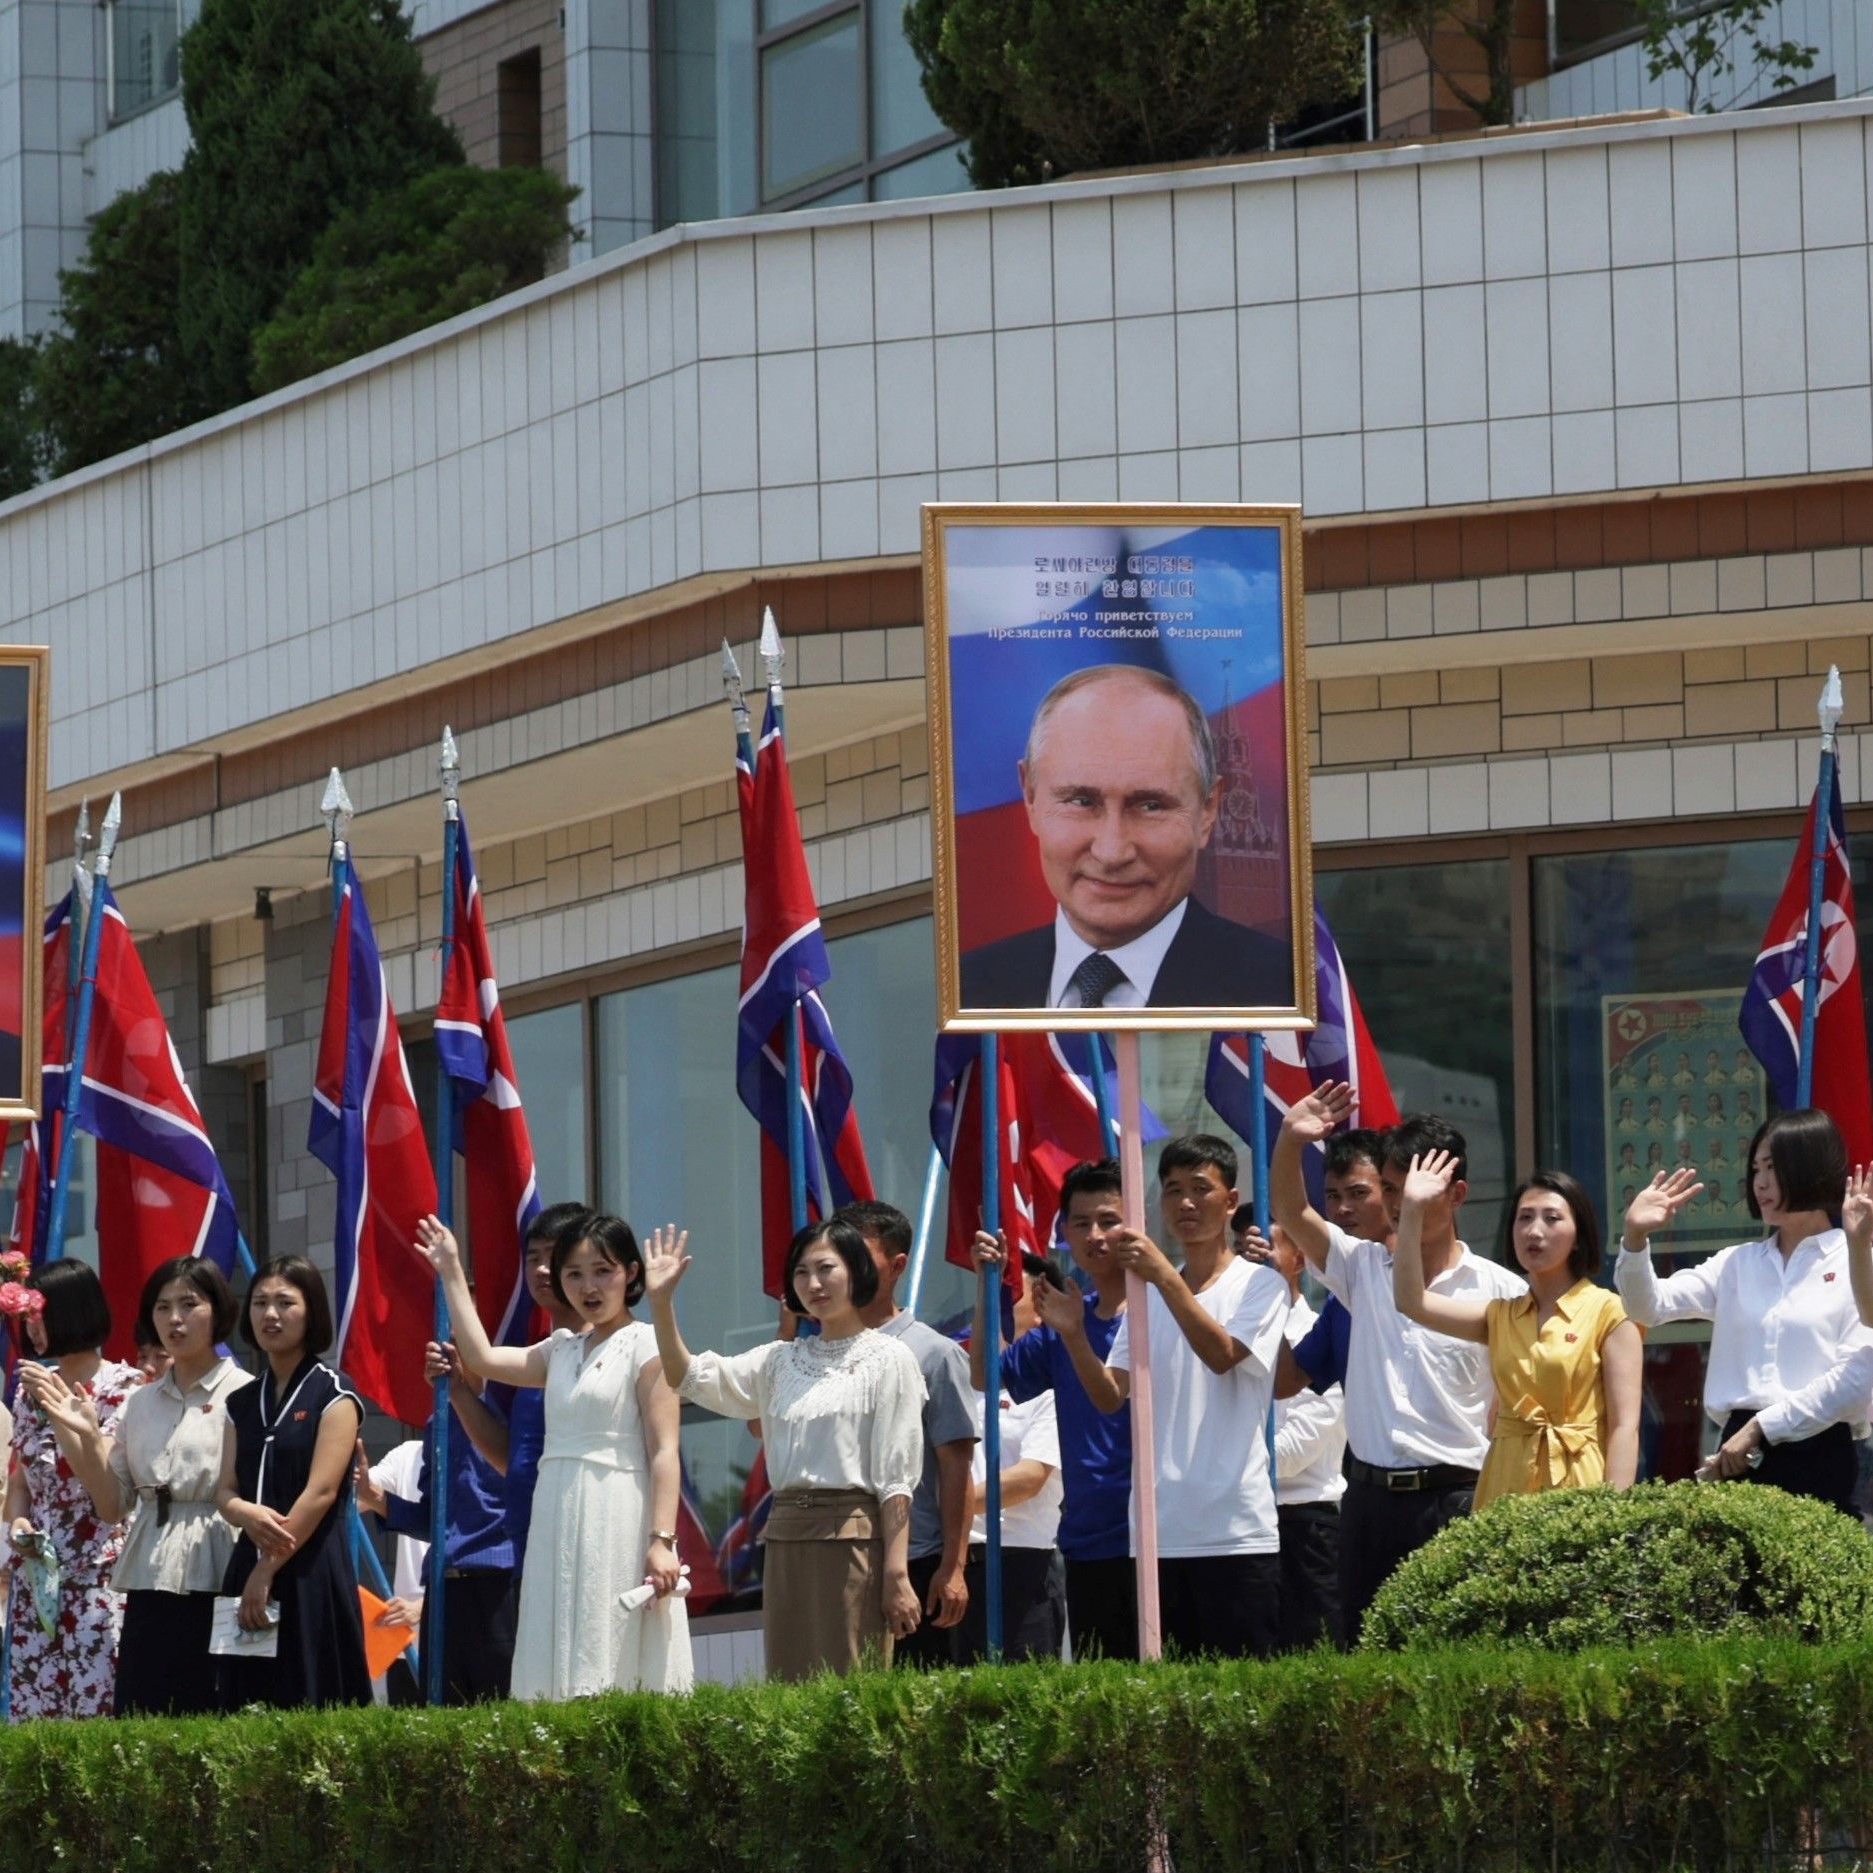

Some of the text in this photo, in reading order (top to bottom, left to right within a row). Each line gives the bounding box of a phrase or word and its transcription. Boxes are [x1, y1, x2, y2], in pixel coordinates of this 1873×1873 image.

[1039, 610, 1193, 624] Горячо приветствуем
[988, 626, 1243, 640] Президента Российской Федерации
